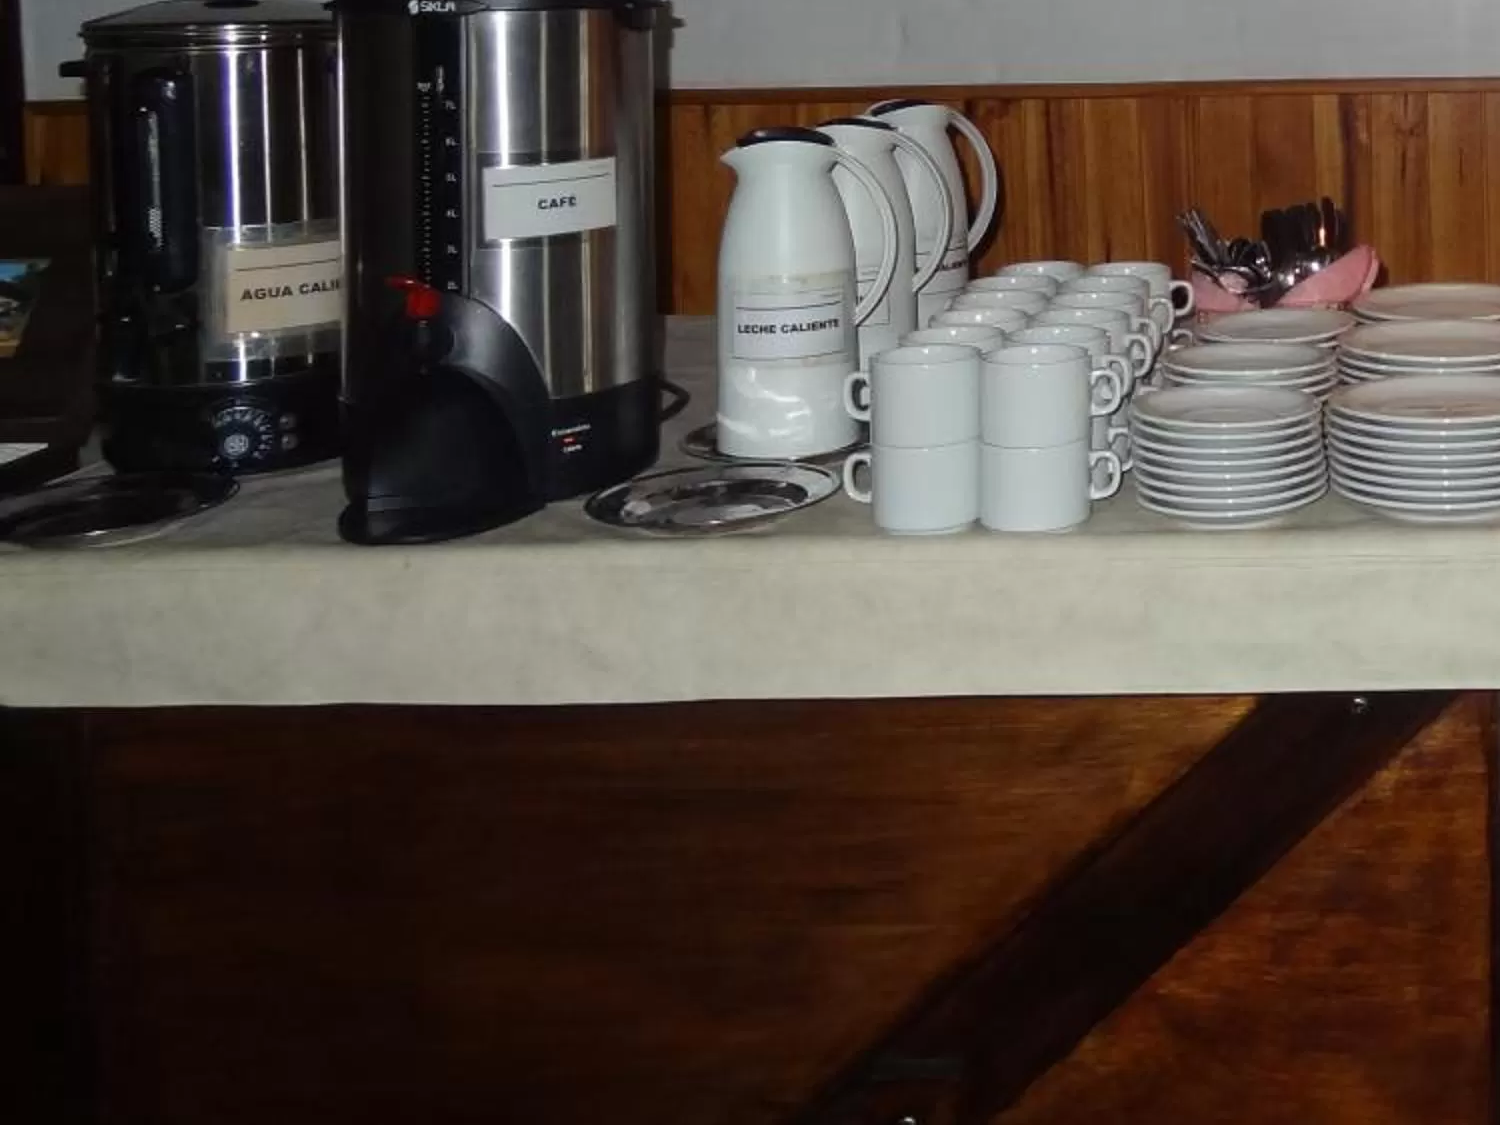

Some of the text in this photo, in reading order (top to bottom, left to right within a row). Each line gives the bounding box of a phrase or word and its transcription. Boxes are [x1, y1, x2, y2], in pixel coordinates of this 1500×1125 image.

[240, 286, 293, 300] AGUA
[737, 318, 839, 334] LECHE CALIENTE
